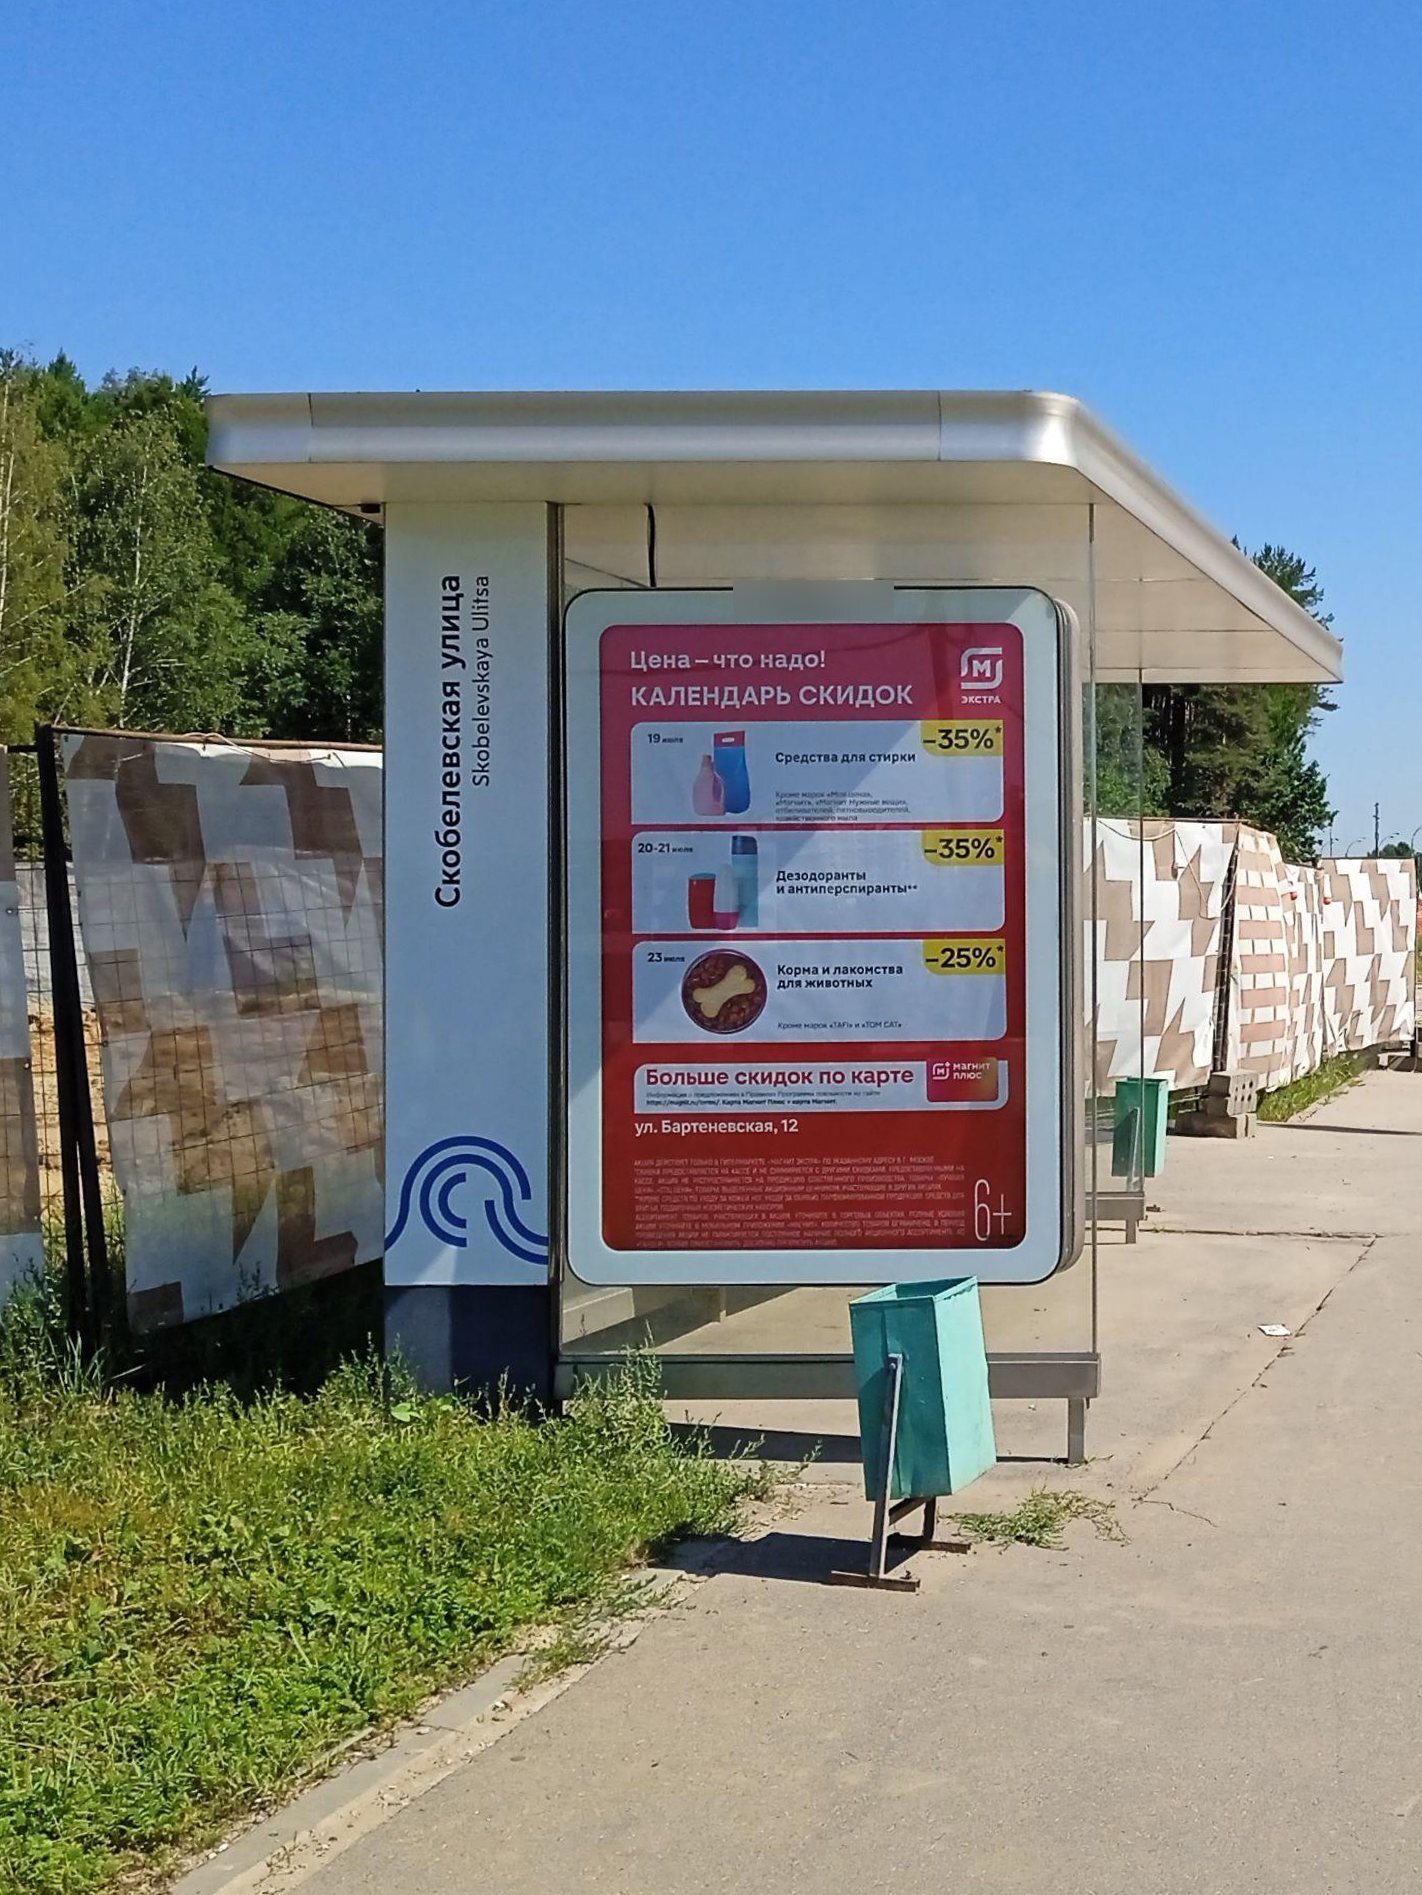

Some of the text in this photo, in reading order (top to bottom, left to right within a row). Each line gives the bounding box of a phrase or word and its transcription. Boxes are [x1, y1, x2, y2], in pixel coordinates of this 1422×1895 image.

[631, 651, 691, 672] Цена
[713, 653, 753, 669] что
[760, 650, 826, 671] надо!
[472, 575, 493, 787] Skobelevskaya Ulitsa
[631, 684, 914, 709] КАЛЕНДАРЬ СКИДОК
[961, 695, 1001, 704] ЭКСТРА
[434, 575, 466, 908] Скобелевская улица
[647, 733, 661, 744] 19
[775, 752, 916, 765] Средства для стирки
[637, 843, 670, 854] 20-21
[776, 871, 866, 883] Дезодоранты
[776, 886, 785, 894] и
[647, 952, 662, 962] 23
[777, 965, 903, 977] Корма и лакомства
[777, 977, 873, 990] для животных
[646, 1068, 914, 1089] Больше скидок по карте
[635, 1118, 799, 1136] ул. Бартеневская, 12
[974, 1178, 1012, 1242] 6+
